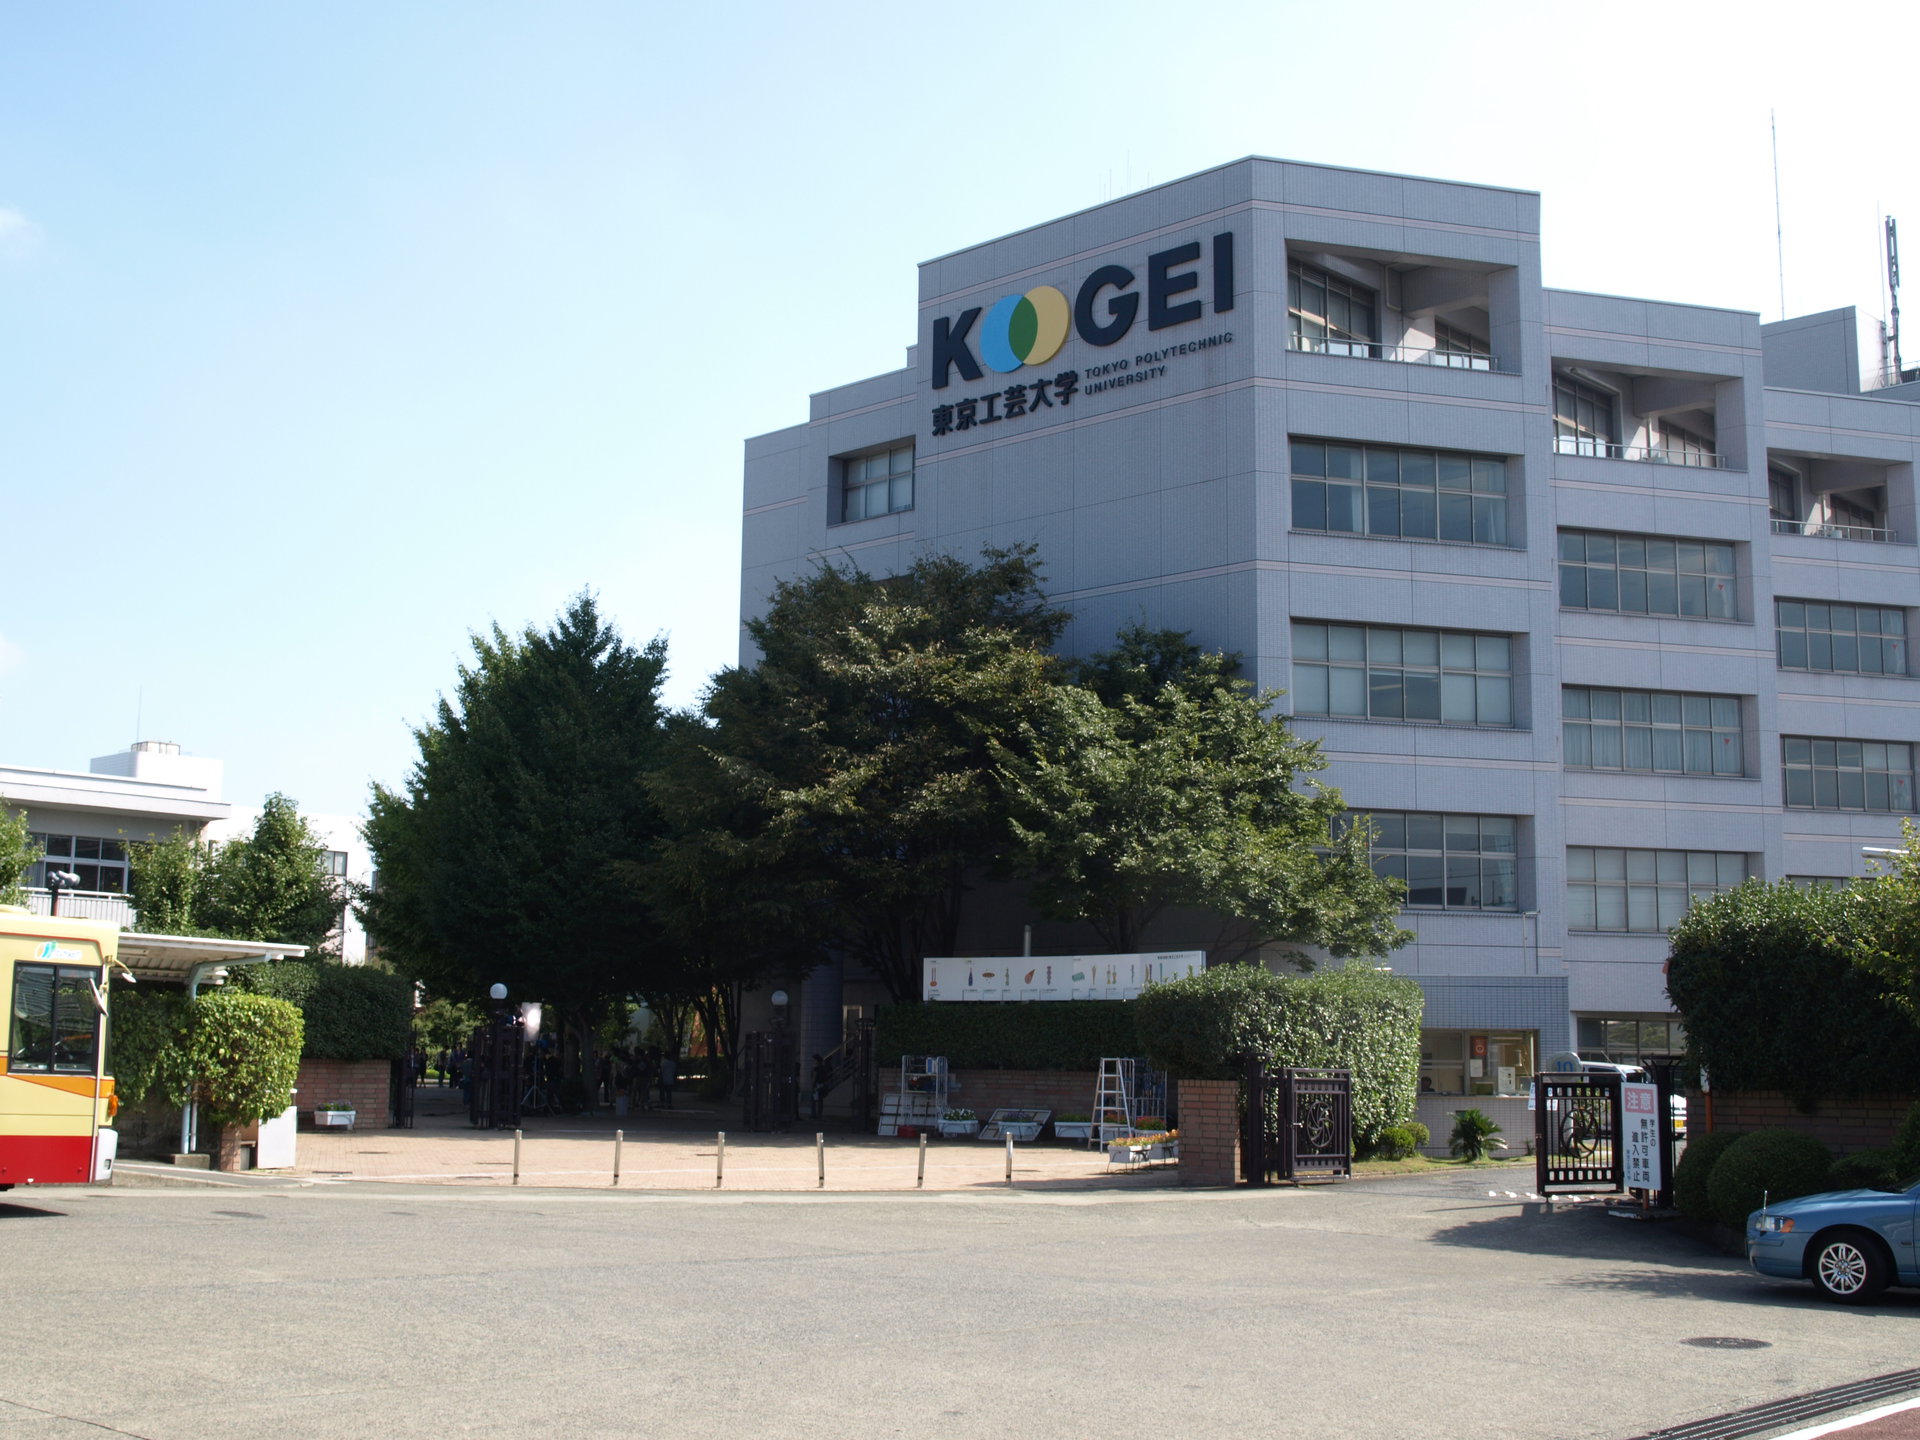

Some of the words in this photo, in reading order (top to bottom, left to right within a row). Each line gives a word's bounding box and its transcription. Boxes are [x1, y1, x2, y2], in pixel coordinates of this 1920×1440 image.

[1085, 359, 1128, 380] TOKYO
[1136, 332, 1233, 367] POLYTECHNIC
[1085, 365, 1166, 396] UNIVERSITY
[931, 369, 1079, 437] 東京工芸大学
[1626, 1091, 1652, 1111] 注意
[1632, 1131, 1641, 1182] 進入禁止
[1640, 1118, 1650, 1183] 無許可車両
